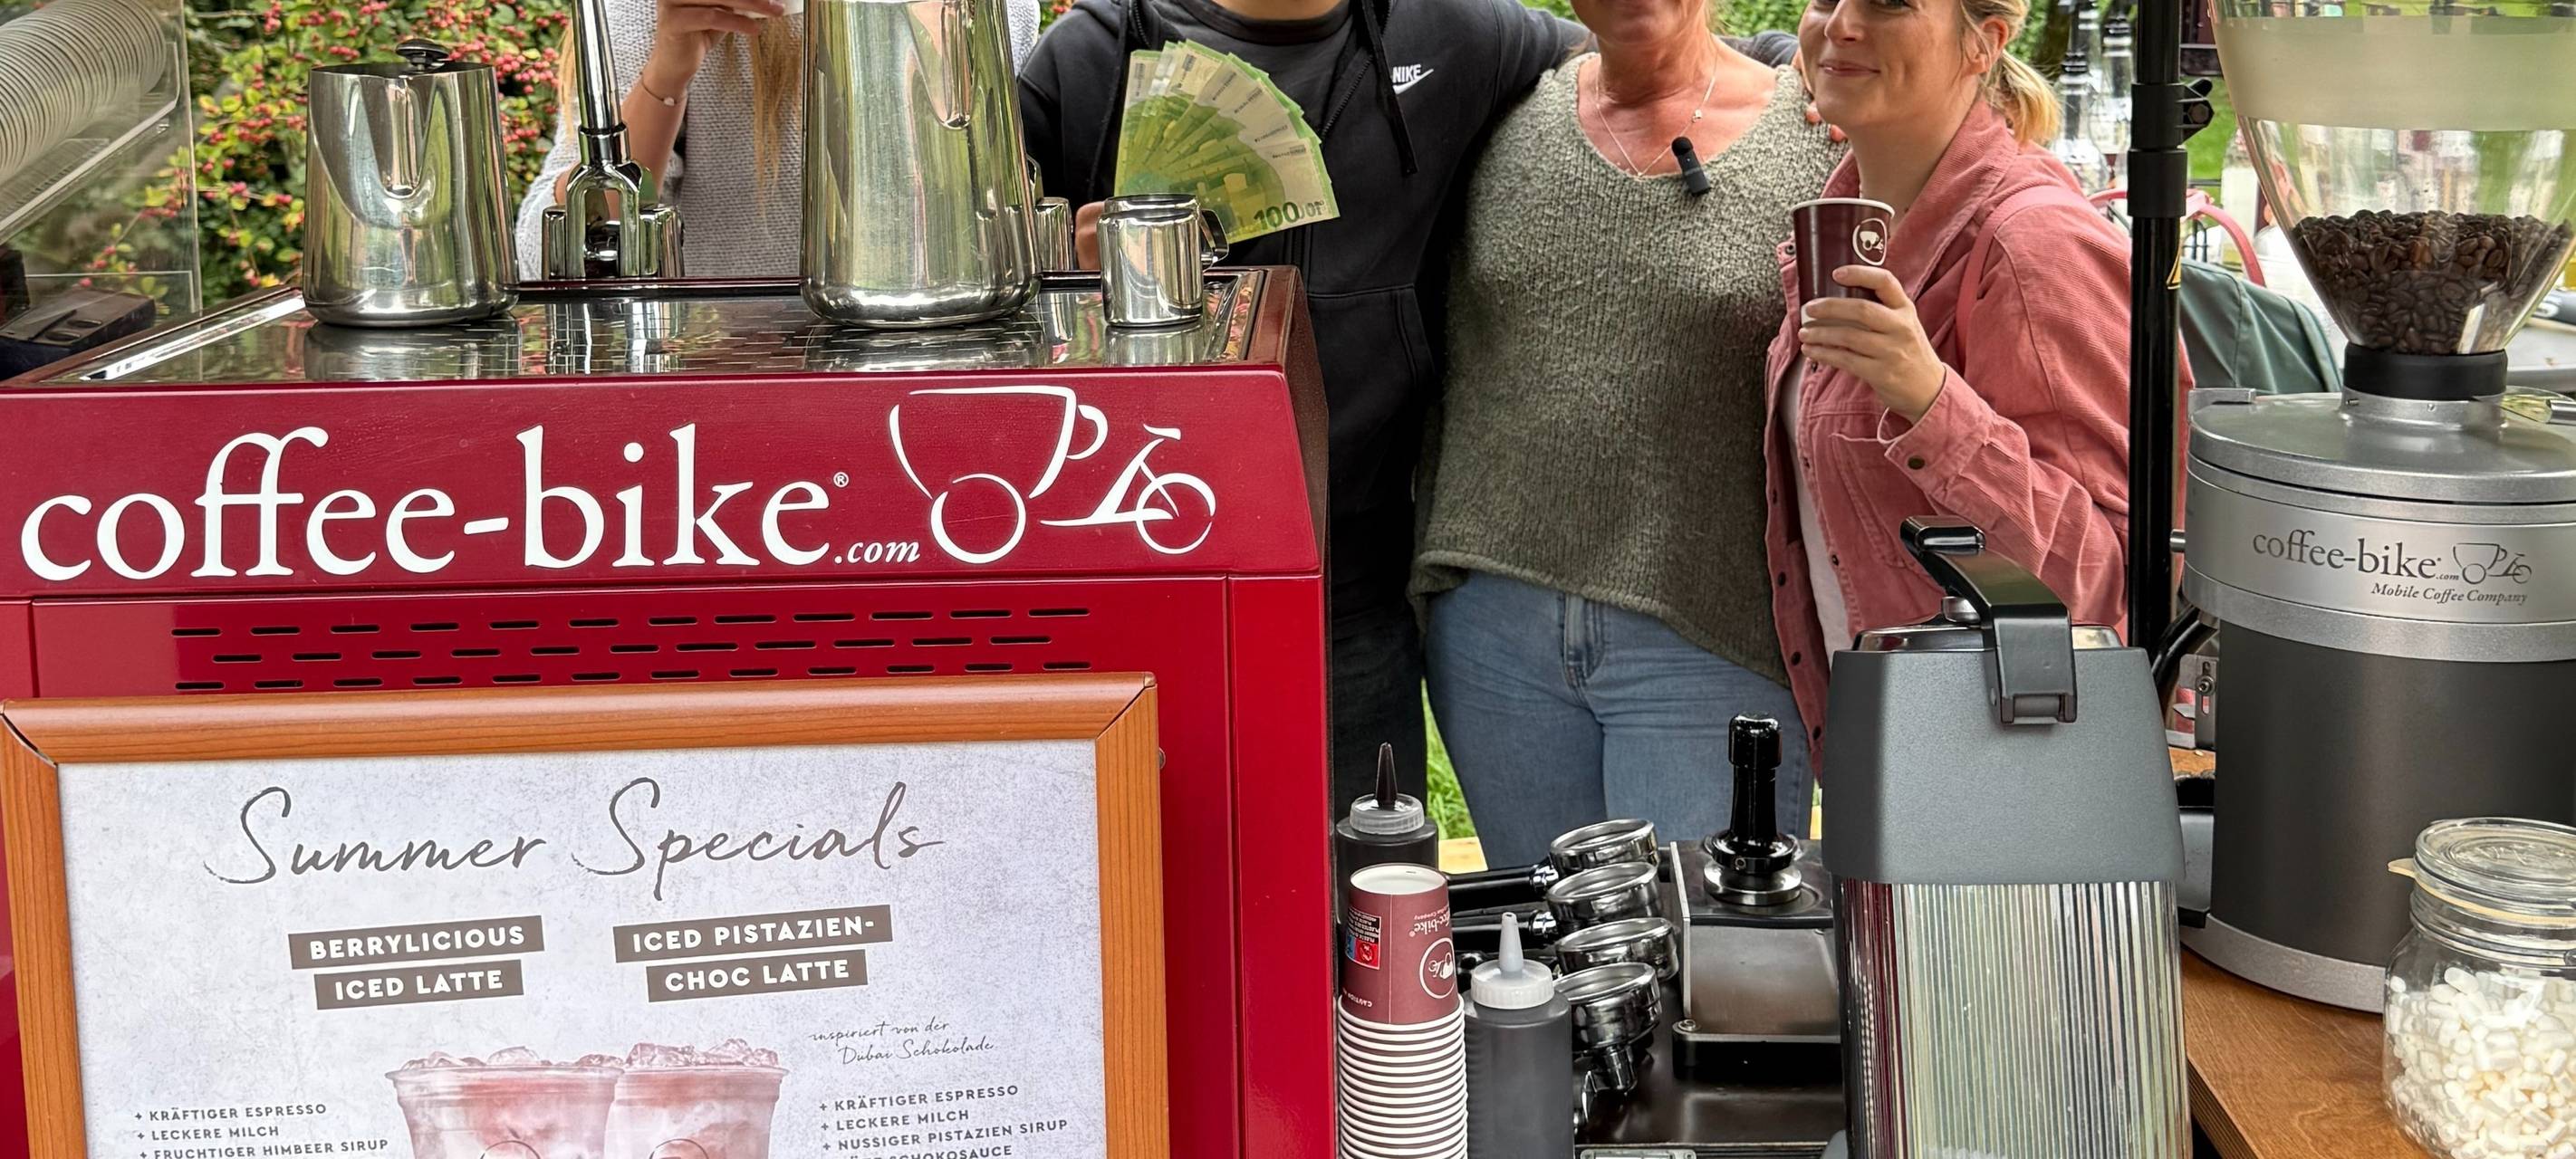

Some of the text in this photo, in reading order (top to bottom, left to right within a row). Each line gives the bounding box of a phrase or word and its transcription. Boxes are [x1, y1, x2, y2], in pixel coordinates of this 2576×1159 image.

[1392, 63, 1421, 83] NIKE
[1254, 201, 1300, 230] 100
[2371, 582, 2528, 606] Mobile Coffee Company
[203, 777, 947, 902] Summer Specials
[310, 925, 524, 960] BERRYLICIOUS
[633, 915, 874, 953] ICED PISTAZIEN-
[335, 970, 503, 1001] ICED LATTE
[665, 959, 850, 992] CHOC LATTE
[892, 1024, 918, 1035] von
[925, 1016, 950, 1031] der
[838, 1036, 994, 1065] Dubai Schokolade
[834, 1093, 928, 1112] KRÄFTIGER
[935, 1085, 1019, 1103] ESPRESSO
[149, 1107, 239, 1122] KRÄFTIGER
[245, 1104, 327, 1117] ESPRESSO
[836, 1115, 911, 1132] LECKERE
[918, 1109, 969, 1125] MILCH
[151, 1128, 222, 1141] LECKERE
[229, 1125, 280, 1138] MILCH
[928, 1125, 1013, 1144] PISTAZIEN
[1020, 1119, 1068, 1134] SIRUP
[154, 1146, 255, 1159] FRUCHTIGER
[263, 1142, 334, 1156] HIMBEER
[341, 1139, 389, 1152] SIRUP
